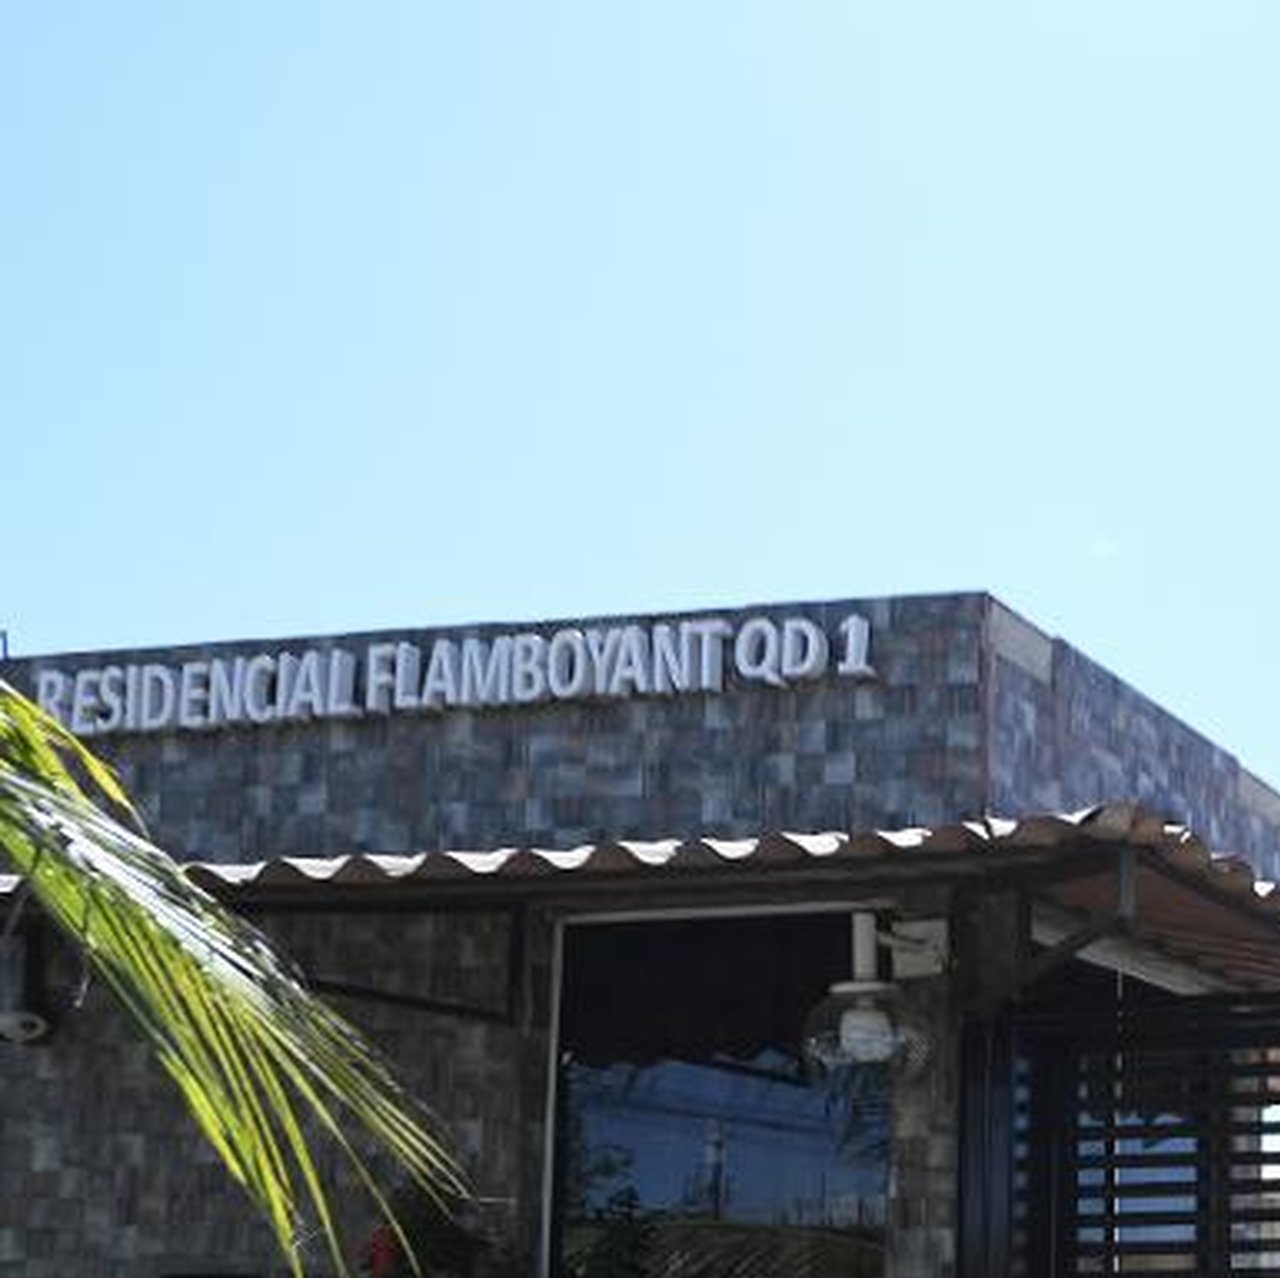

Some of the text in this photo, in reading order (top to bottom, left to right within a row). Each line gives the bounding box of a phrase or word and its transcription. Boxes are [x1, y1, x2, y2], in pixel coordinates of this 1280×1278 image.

[36, 614, 875, 735] RESIDENCIAL FLAMBOYANT QD 1
